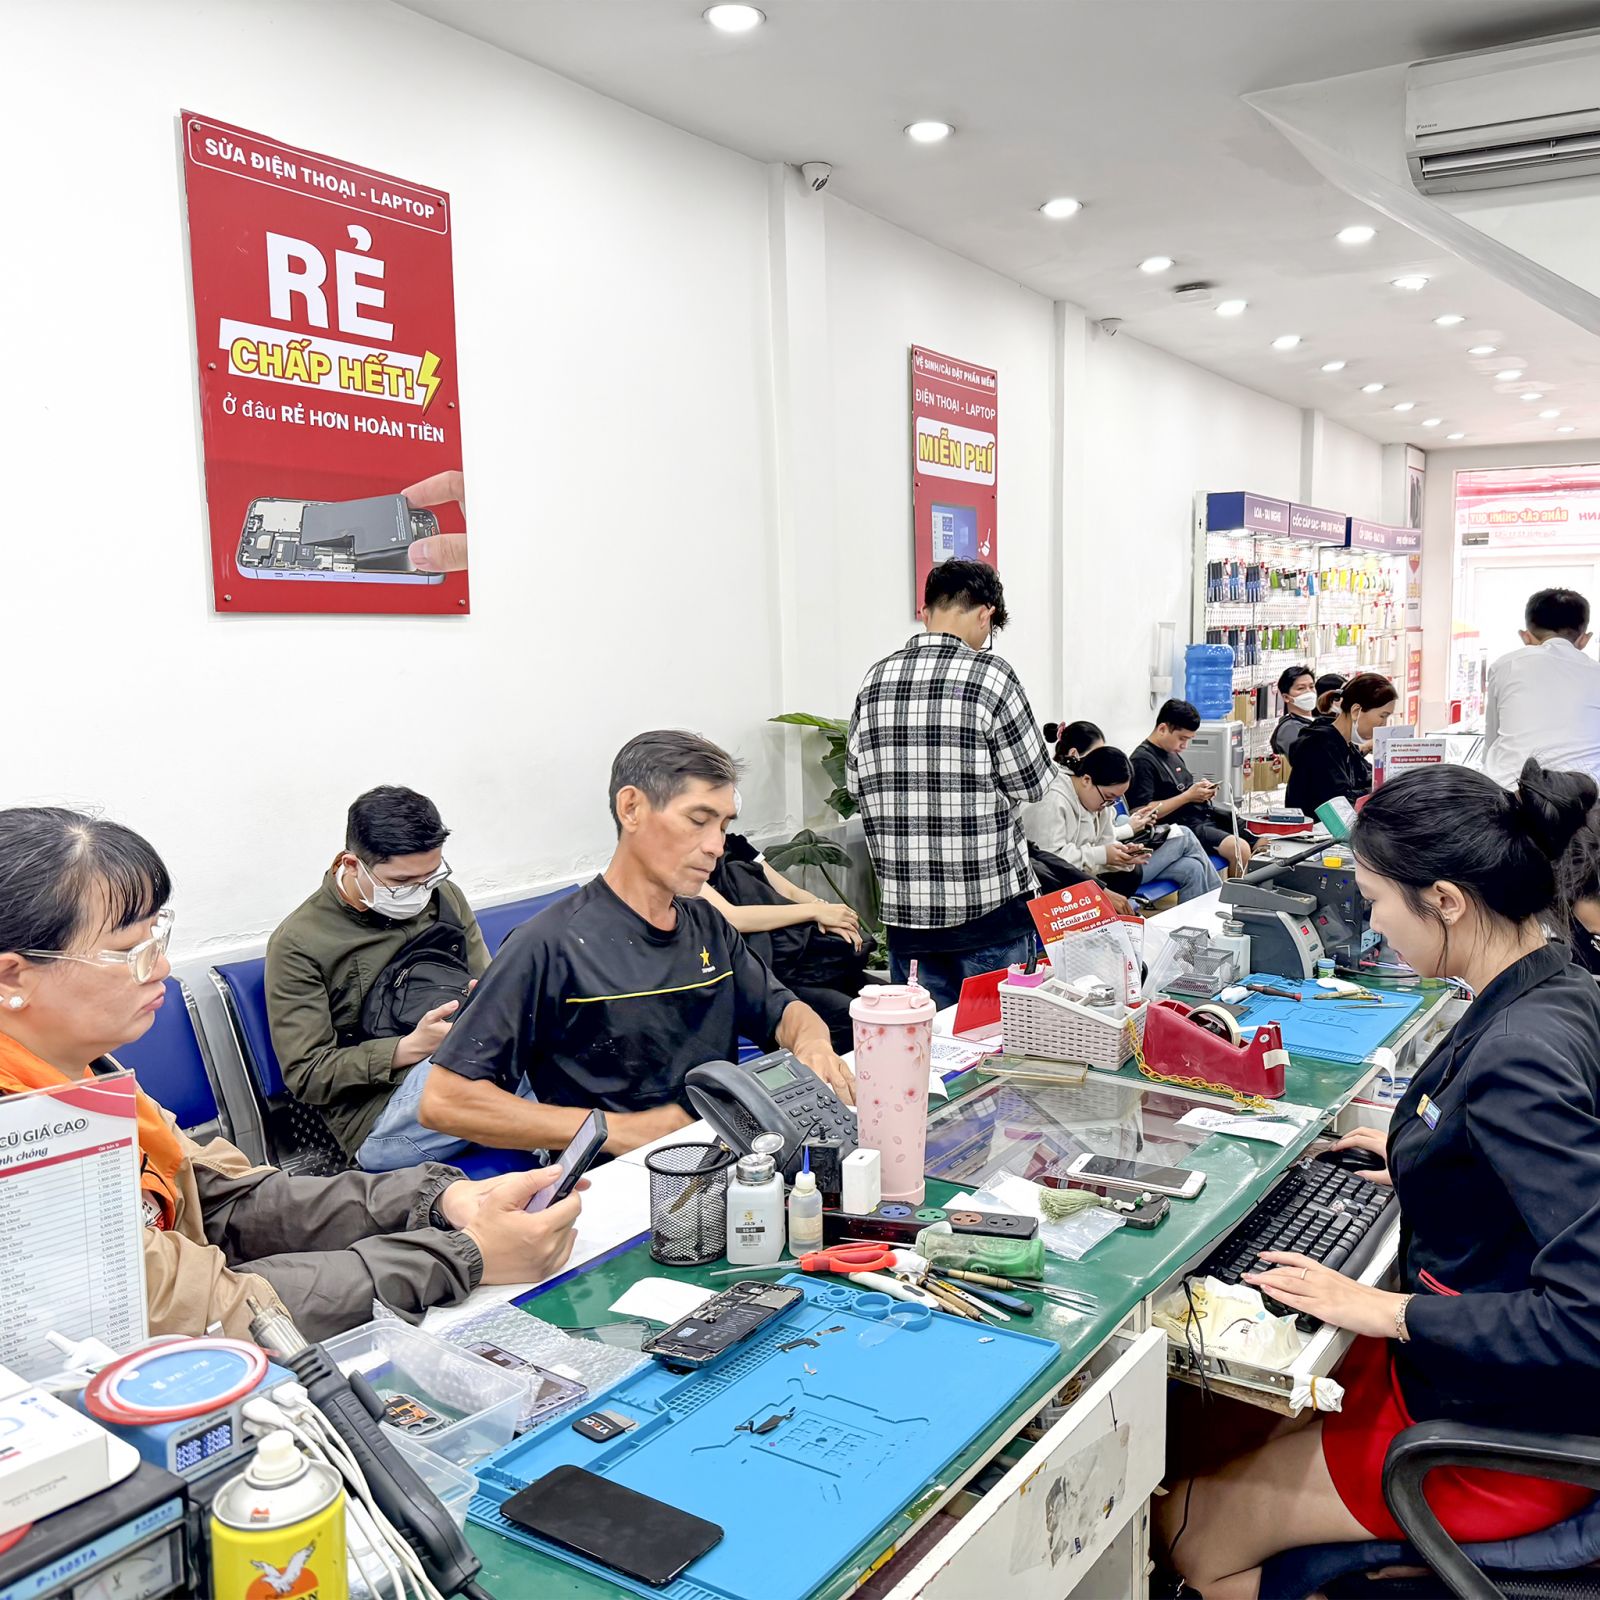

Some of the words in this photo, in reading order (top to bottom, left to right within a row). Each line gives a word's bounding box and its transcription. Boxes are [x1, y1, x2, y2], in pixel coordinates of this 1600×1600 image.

[205, 137, 246, 165] SỬA
[250, 155, 297, 181] ĐIỆN
[301, 166, 356, 199] THOẠI
[371, 188, 435, 219] LAPTOP
[266, 224, 394, 342] RẺ
[230, 338, 332, 385] CHẤP
[338, 354, 415, 400] HẾT!
[222, 391, 238, 415] Ở
[281, 403, 305, 425] RẺ
[309, 409, 349, 431] HƠN
[354, 416, 403, 438] HOÀN
[407, 420, 445, 443] TIỀN
[915, 388, 935, 407] ĐIỆN
[936, 394, 960, 415] THOẠI
[966, 402, 996, 420] LAPTOP
[918, 427, 962, 469] MIỄN
[964, 442, 994, 474] PHÍ
[1050, 902, 1079, 916] iPhone
[1079, 895, 1091, 906] Cũ
[23, 1124, 51, 1142] GIÁ
[53, 1118, 87, 1134] CAO
